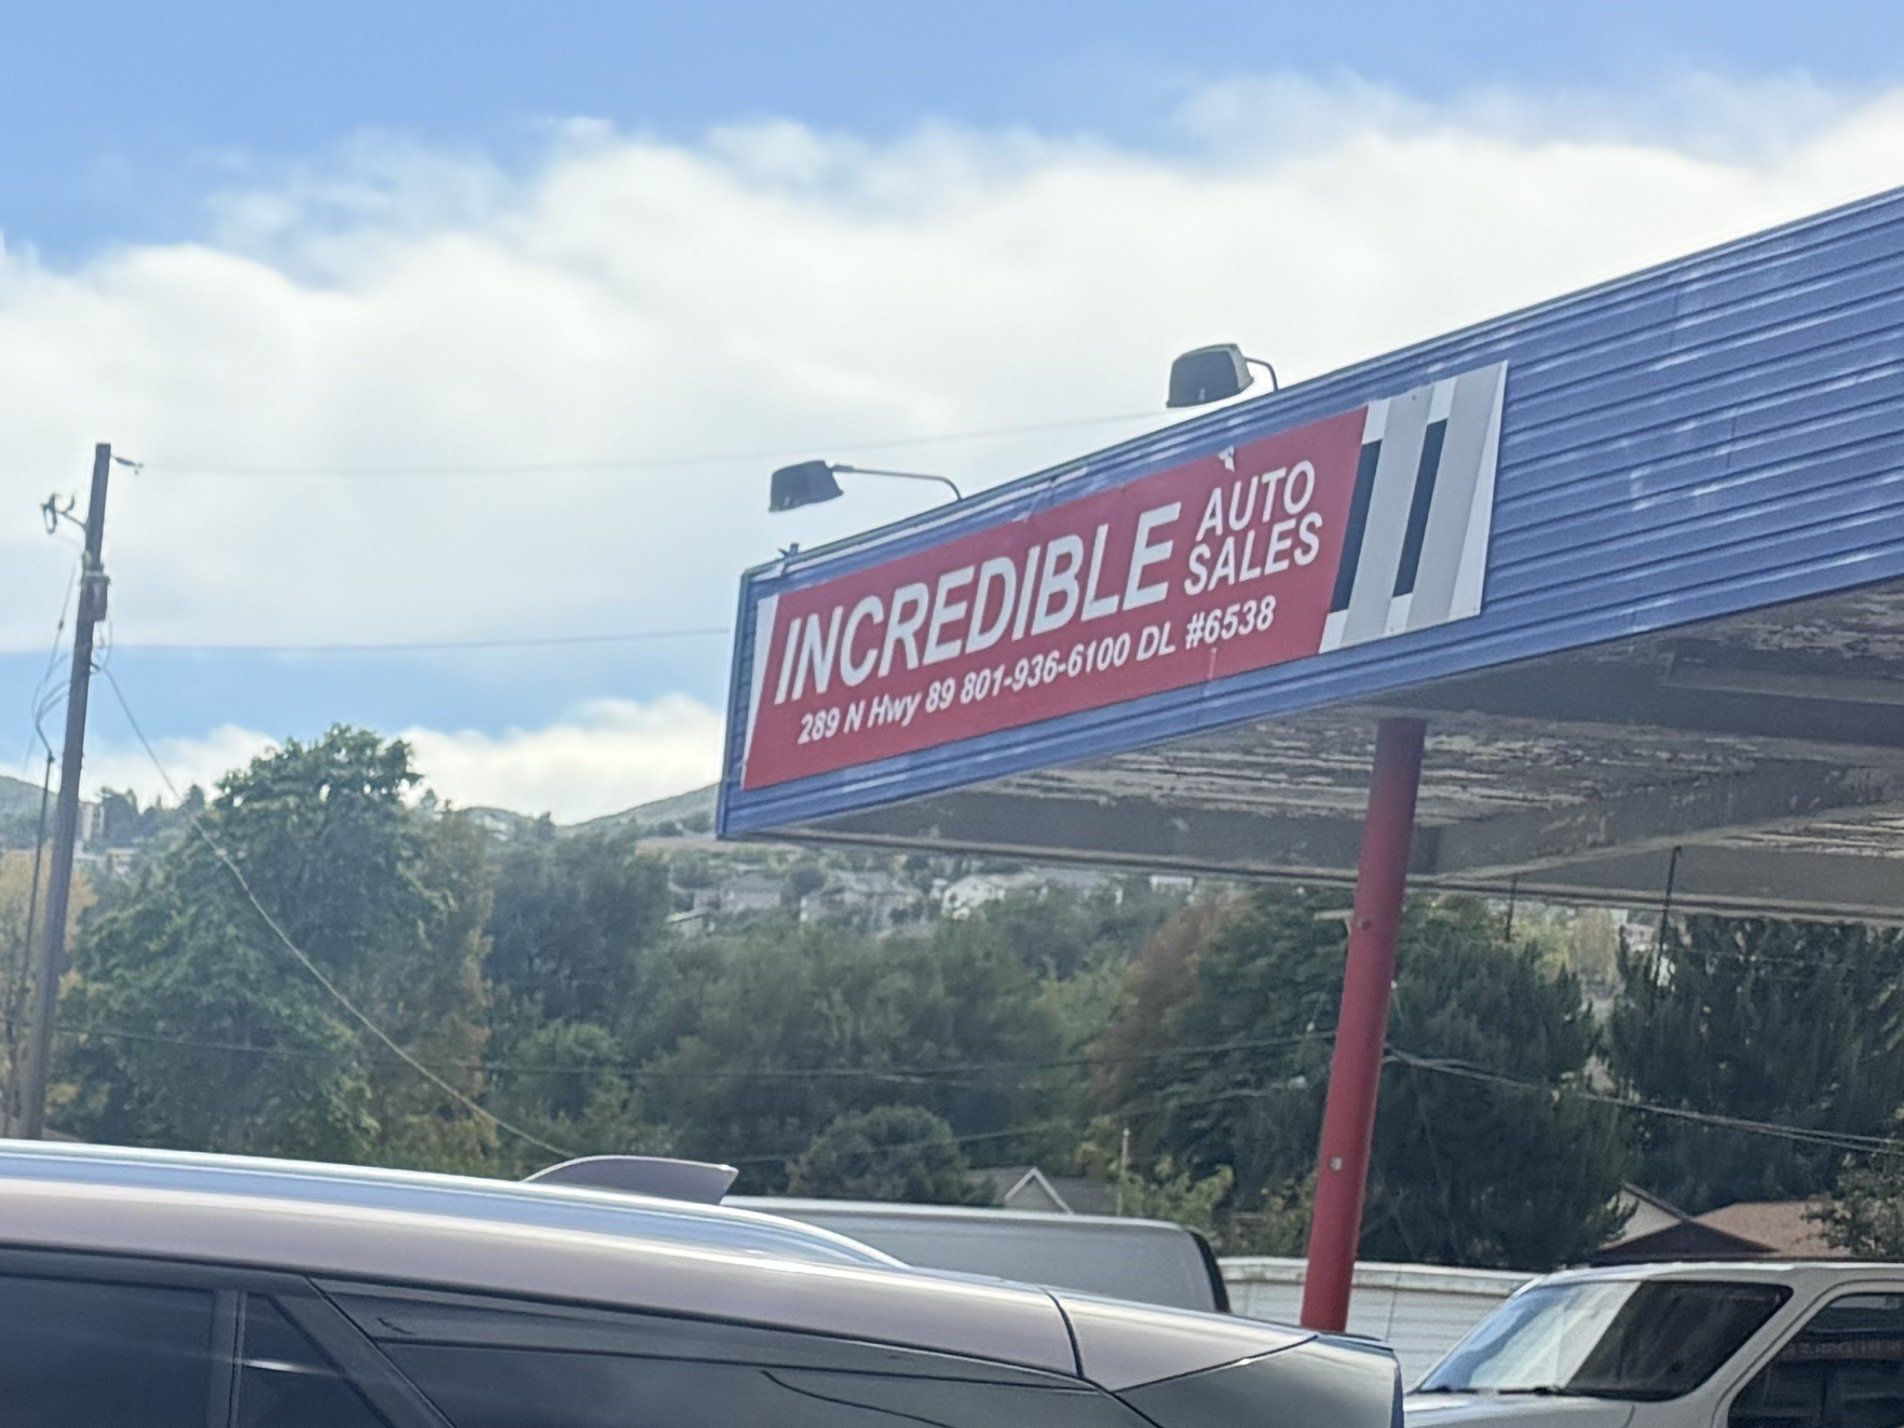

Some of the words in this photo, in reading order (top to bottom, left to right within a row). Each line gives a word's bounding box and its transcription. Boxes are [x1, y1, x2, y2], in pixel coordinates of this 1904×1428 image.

[1184, 512, 1323, 596] SALES
[1195, 460, 1315, 542] AUTO
[774, 502, 1182, 705] INCREDIBLE
[797, 706, 838, 745] 289
[844, 708, 866, 734] N
[867, 691, 922, 728] Hwy
[925, 677, 956, 714] 89
[960, 633, 1131, 702] 801-936-6100
[1136, 622, 1176, 661] DL
[1185, 595, 1276, 650] #6538
